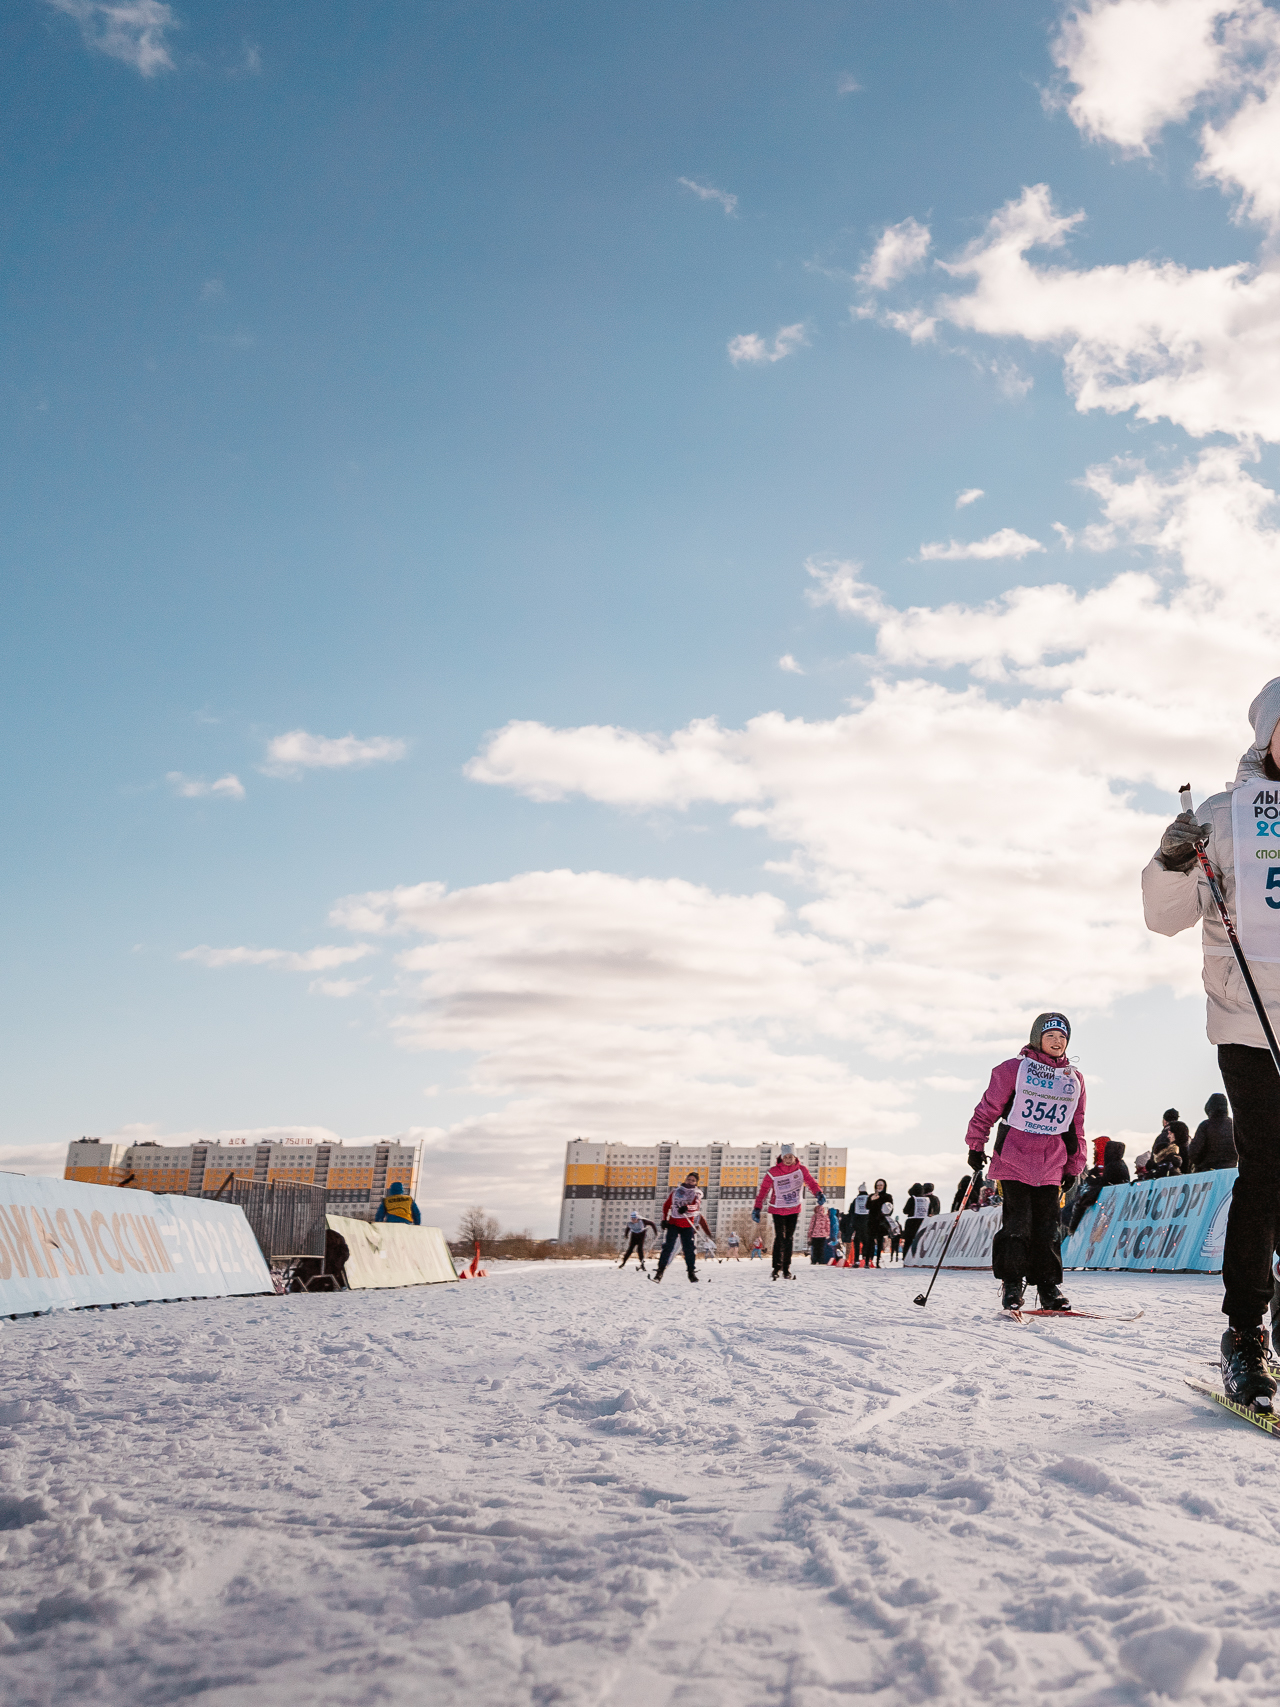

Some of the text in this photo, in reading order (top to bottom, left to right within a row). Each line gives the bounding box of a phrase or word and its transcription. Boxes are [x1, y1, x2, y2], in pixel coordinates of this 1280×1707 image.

[1025, 1075, 1054, 1089] 2022
[1027, 1067, 1055, 1080] РОССИИ
[1021, 1098, 1068, 1124] 3543
[1024, 1120, 1058, 1132] ТВЕРСКАЯ
[1117, 1181, 1214, 1222] МИНСПОРТ
[73, 1207, 176, 1275] РОССИИ
[1112, 1224, 1188, 1259] РОССИИ
